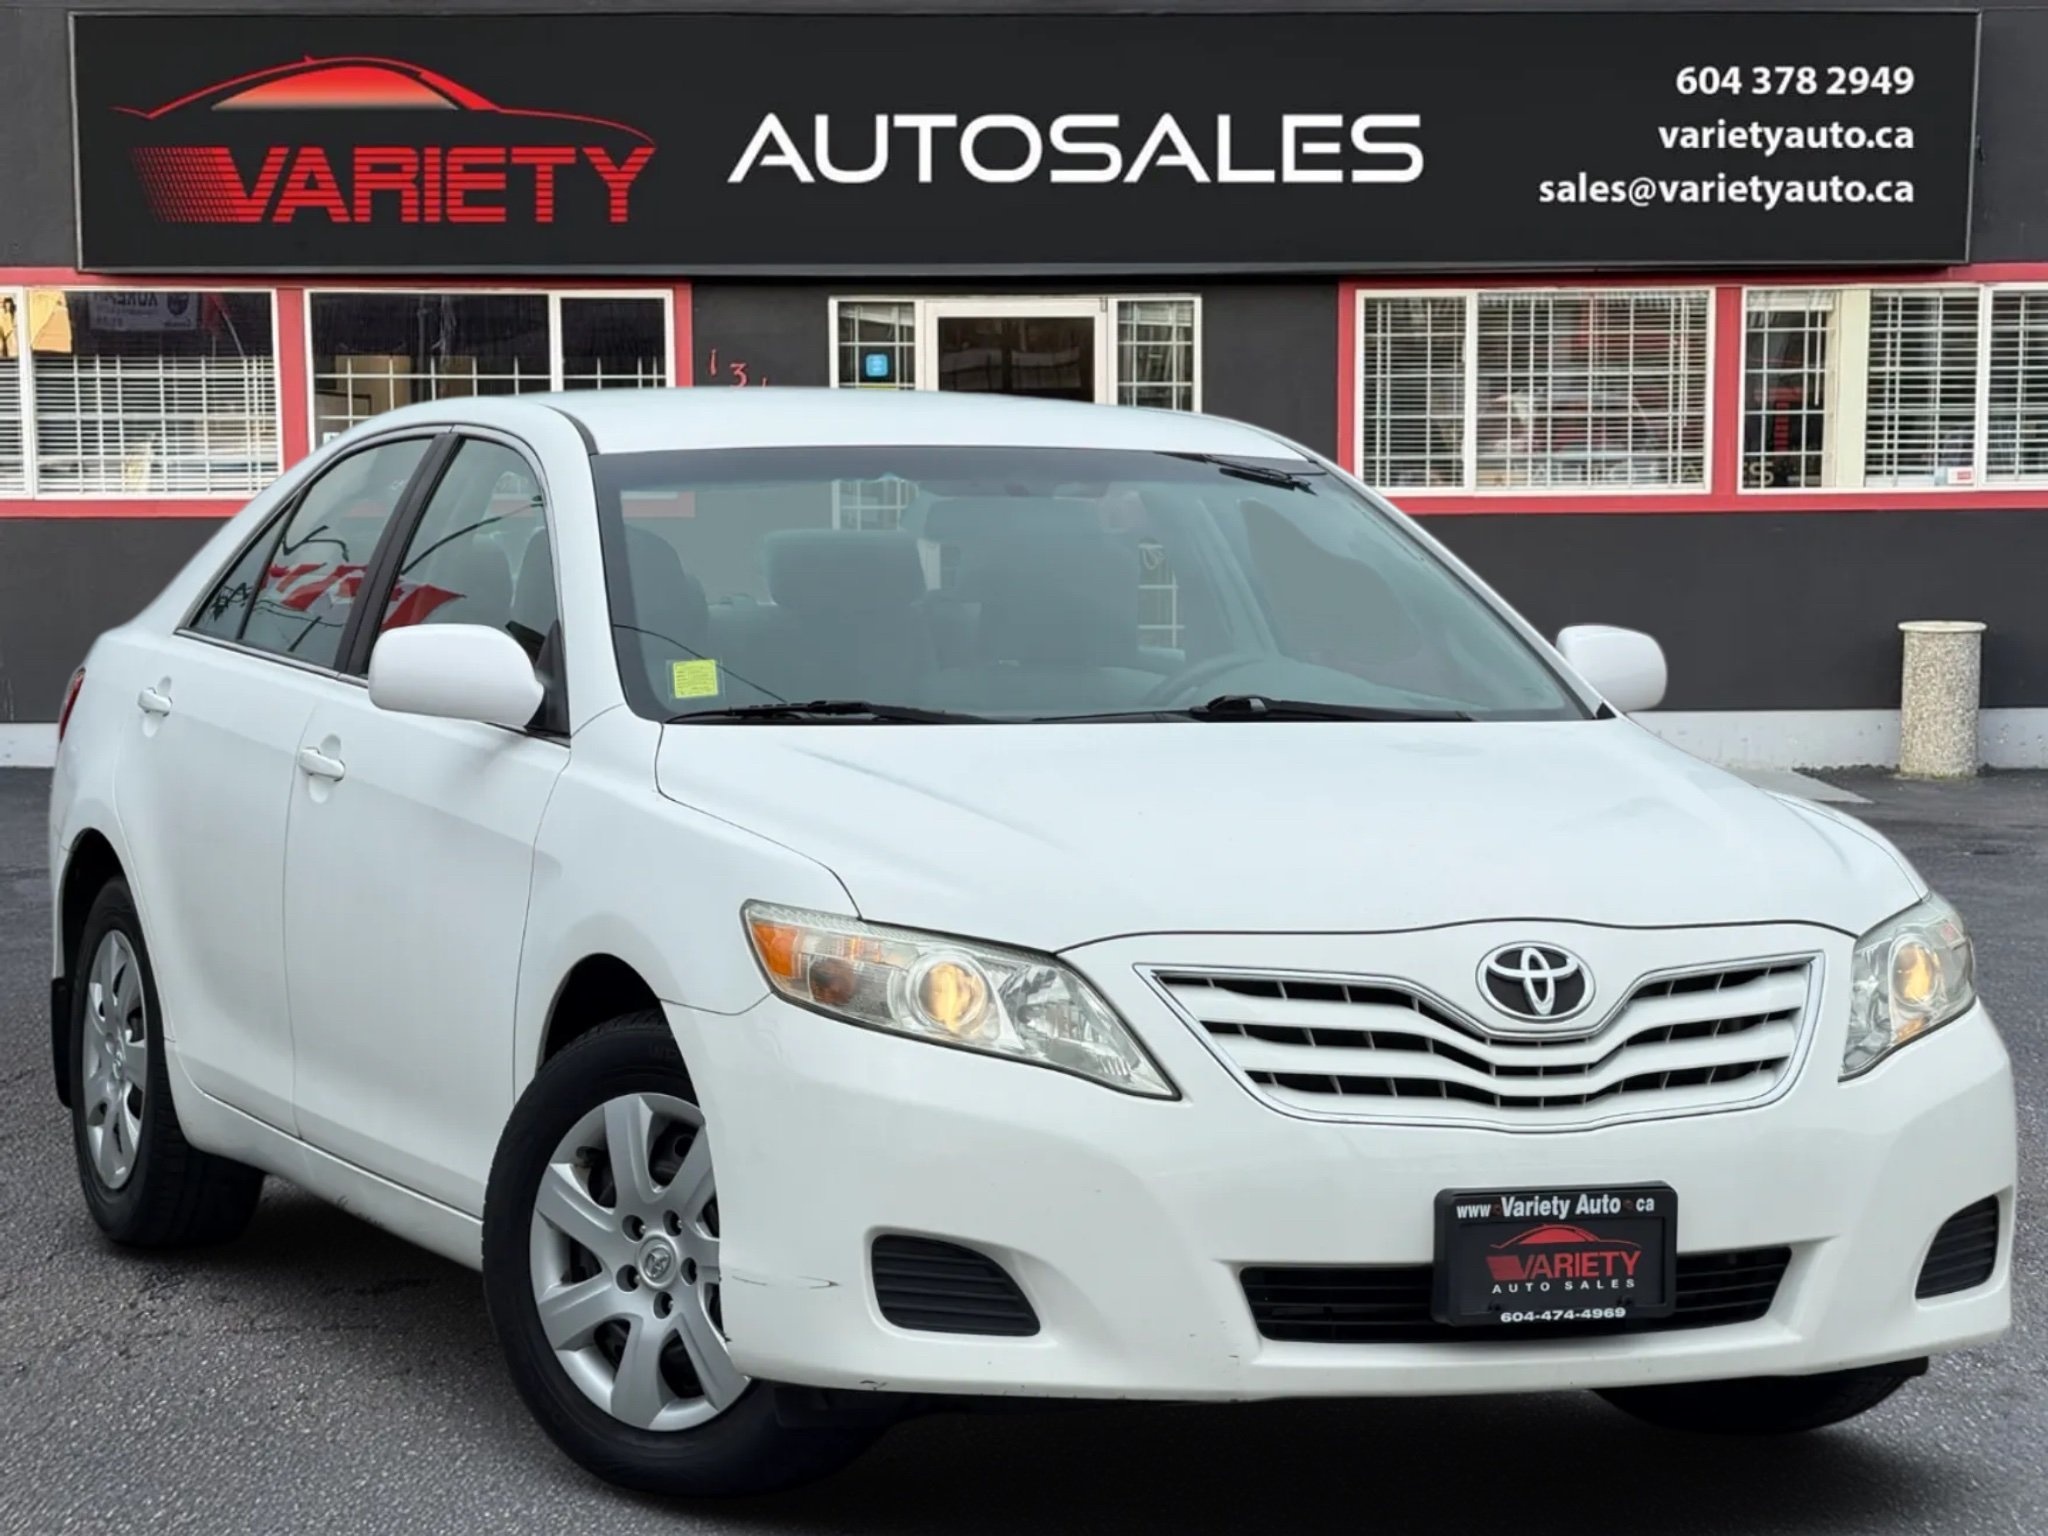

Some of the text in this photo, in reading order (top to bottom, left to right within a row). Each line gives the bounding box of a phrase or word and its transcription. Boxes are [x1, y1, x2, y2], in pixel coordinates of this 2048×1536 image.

[1676, 66, 1915, 95] 604 378 2949
[727, 112, 1424, 184] AUTOSALES
[1658, 118, 1914, 157] varietyauto.ca
[134, 146, 657, 224] VARIETY
[1539, 172, 1914, 211] sales@varietyauto.ca
[1456, 1193, 1655, 1220] www Variety Auto ca
[1486, 1250, 1641, 1281] VARIETY
[1492, 1278, 1635, 1294] AUTO SALES
[1500, 1306, 1627, 1323] 604-474-4969
